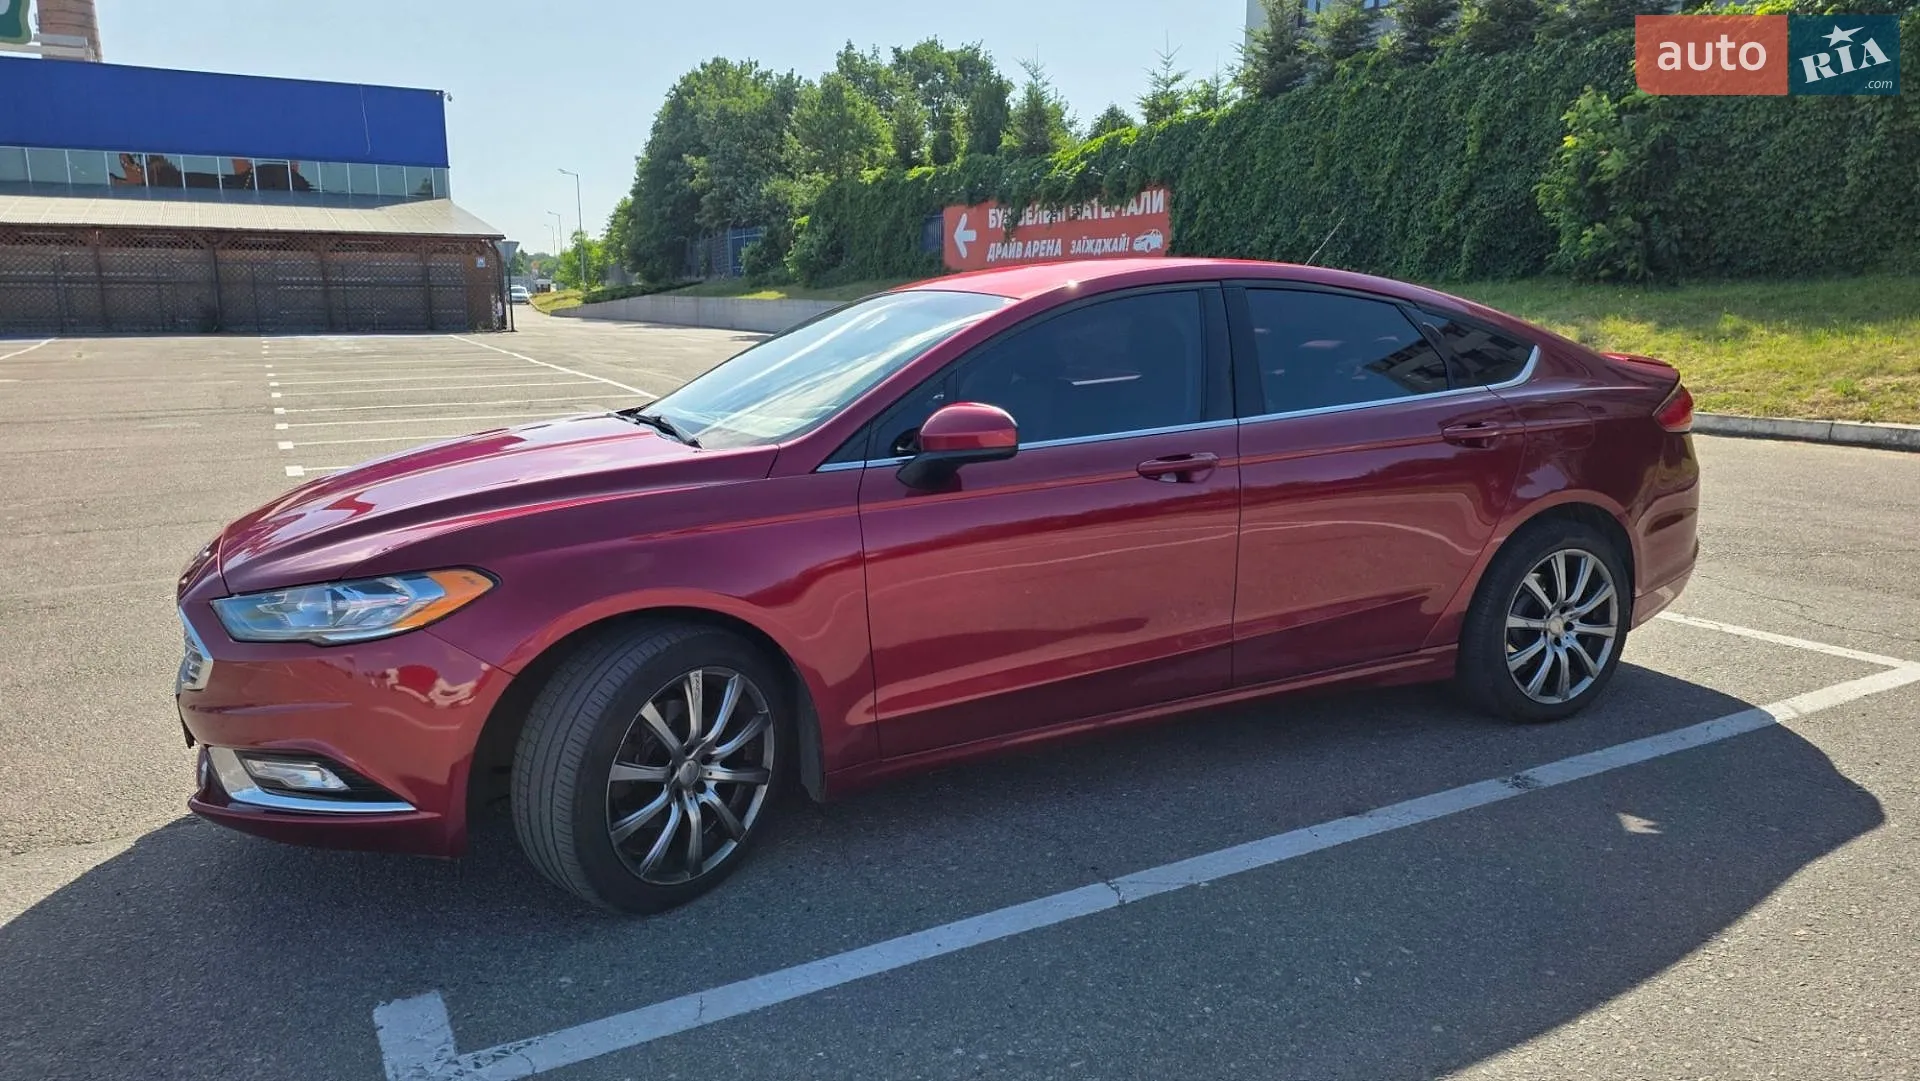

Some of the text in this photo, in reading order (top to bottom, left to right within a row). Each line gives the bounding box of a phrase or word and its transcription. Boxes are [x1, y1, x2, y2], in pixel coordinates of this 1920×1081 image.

[987, 233, 1130, 262] ДРАЙВ АРЕНА ЗАЇЖДЖАЙ!
